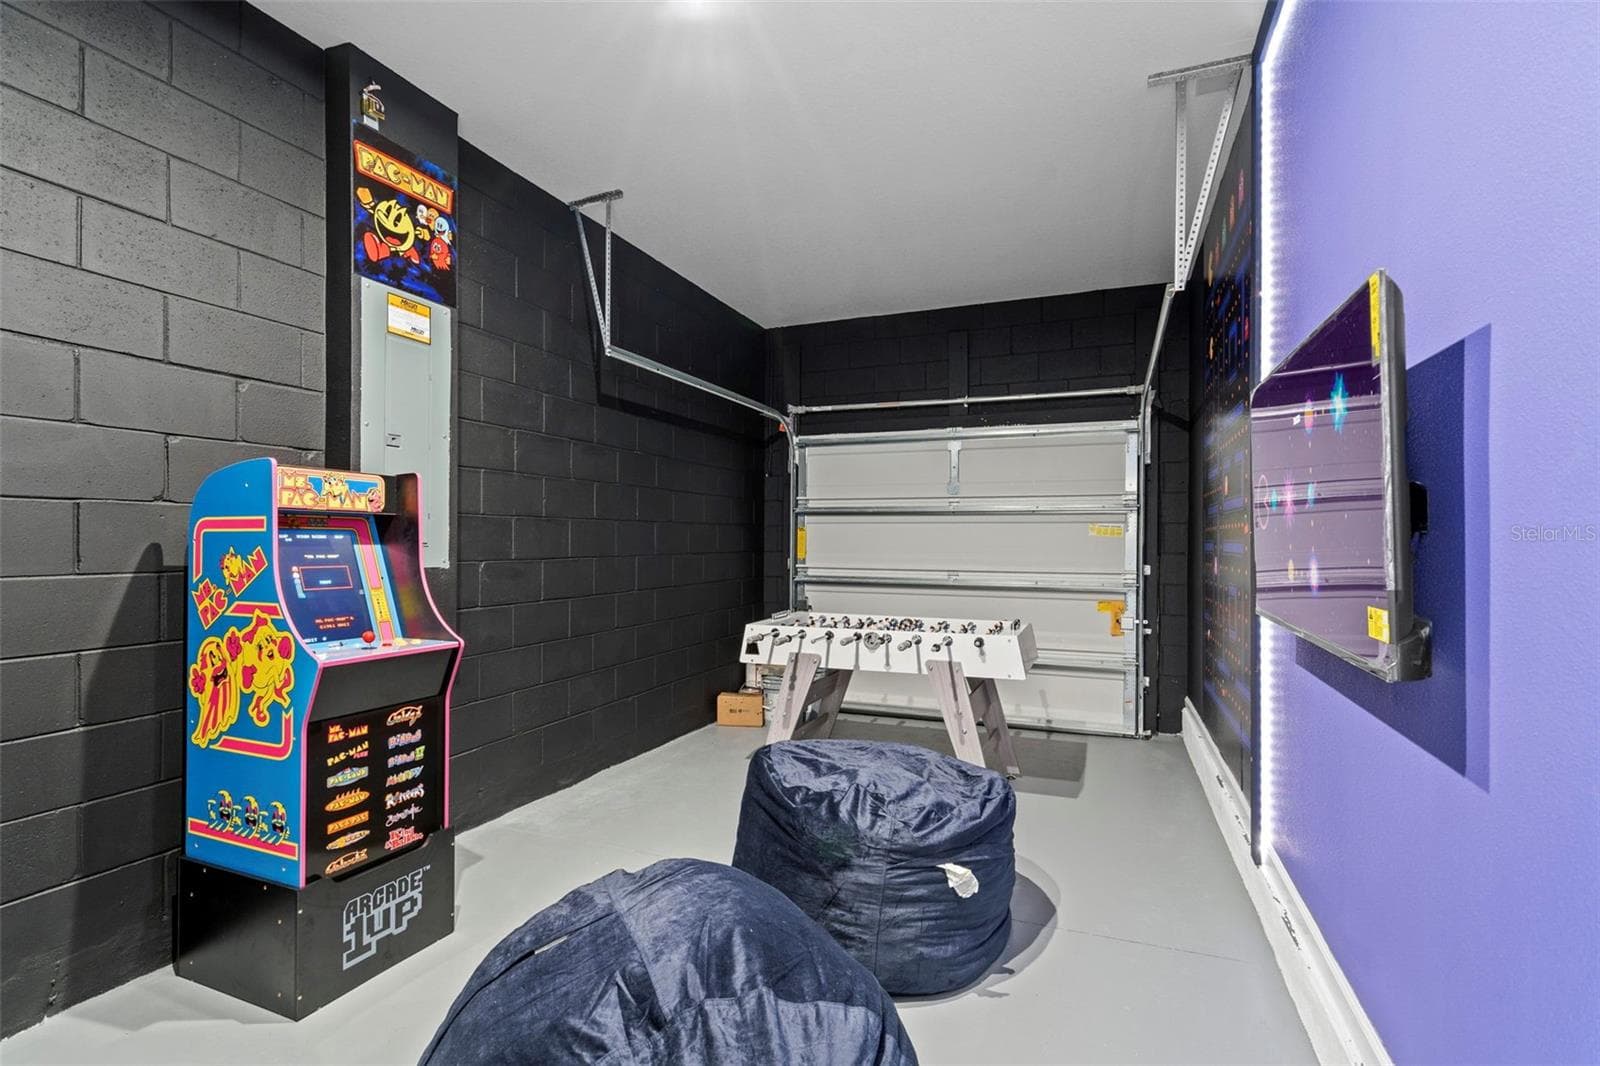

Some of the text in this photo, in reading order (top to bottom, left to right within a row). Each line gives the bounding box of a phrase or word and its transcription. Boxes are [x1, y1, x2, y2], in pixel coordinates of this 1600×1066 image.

[358, 147, 449, 208] PAC-MAN
[281, 490, 368, 510] PAC-MAN
[326, 740, 369, 767] PAC-MAN
[328, 724, 369, 744] PAC-MAN
[343, 868, 423, 926] ARCADE
[342, 892, 422, 971] 1UP
